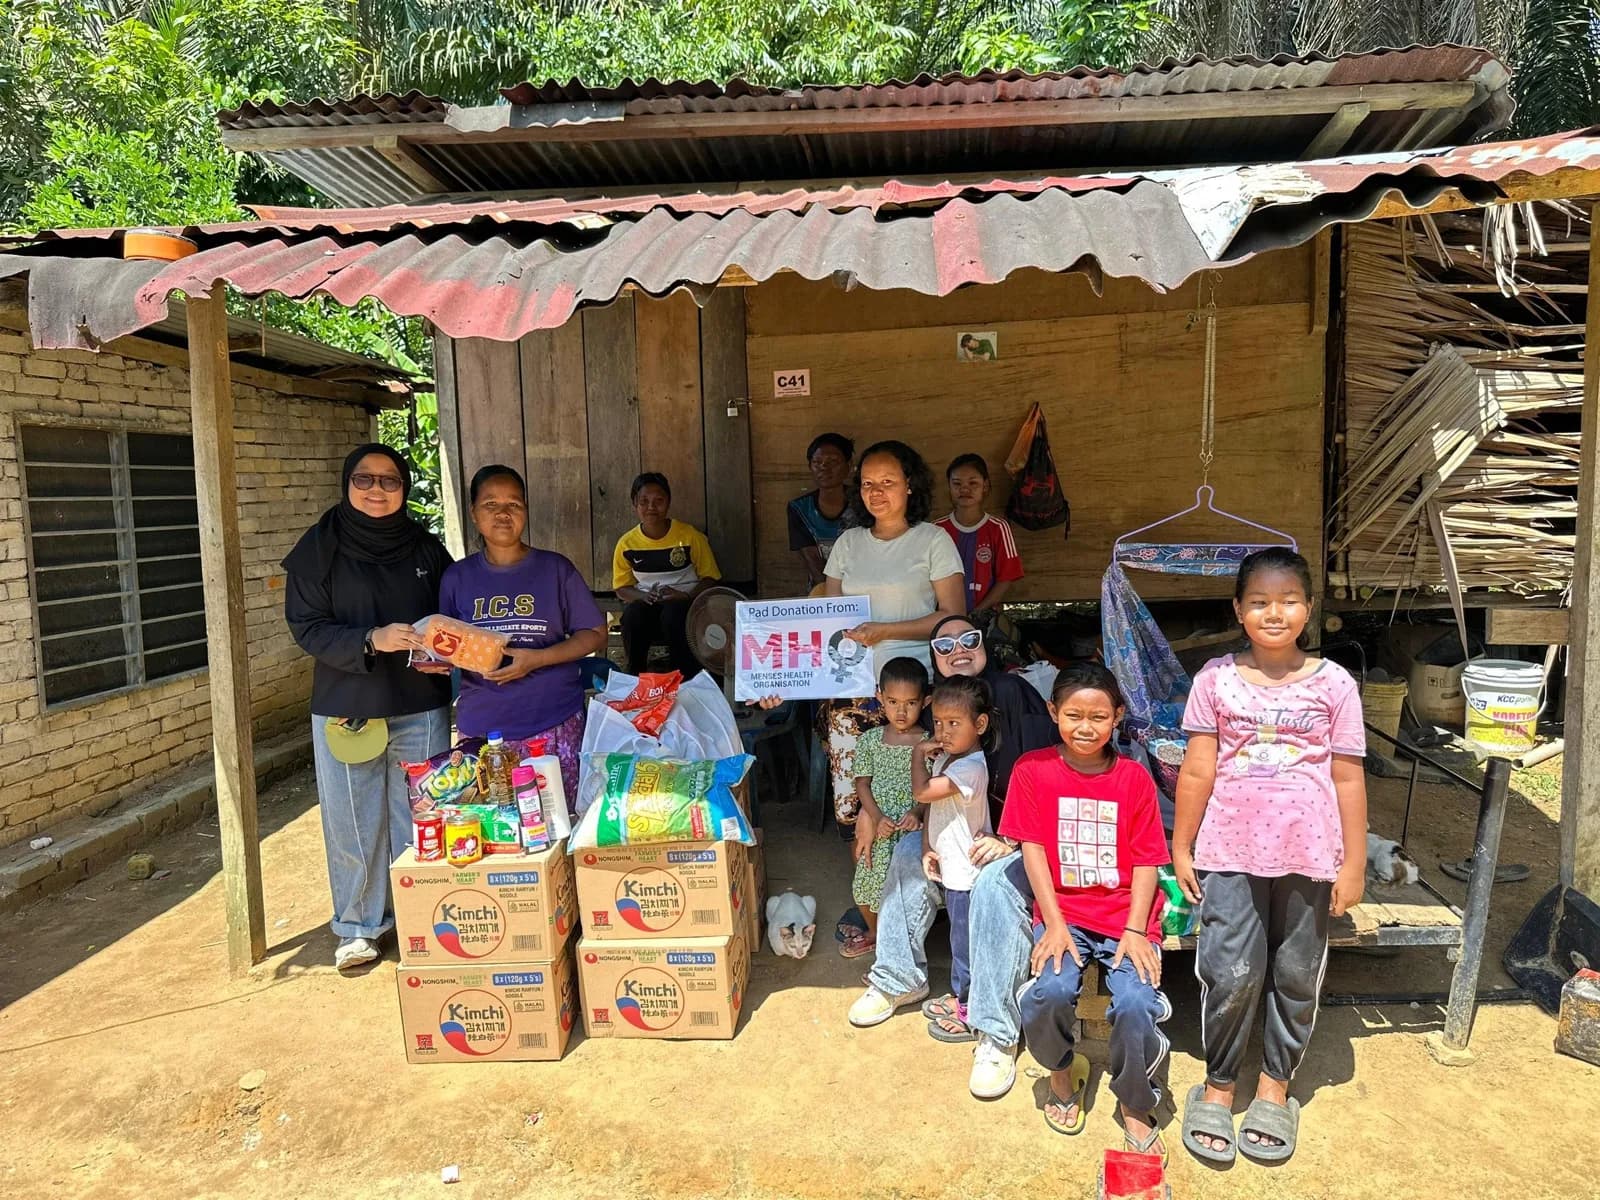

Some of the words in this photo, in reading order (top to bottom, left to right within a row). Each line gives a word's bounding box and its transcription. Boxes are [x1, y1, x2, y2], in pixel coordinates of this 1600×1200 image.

[778, 374, 804, 387] C41
[472, 594, 534, 620] I.C.S
[749, 607, 768, 618] Pad
[772, 602, 823, 616] Donation
[826, 602, 859, 613] From:
[751, 672, 782, 680] MENSES
[753, 680, 810, 688] ORGANISATION
[1270, 708, 1315, 733] Tasty
[628, 772, 662, 832] Spcial
[624, 880, 677, 897] Kimchi
[640, 899, 679, 909] 김치찌개
[441, 904, 497, 921] Kimchi
[459, 923, 499, 934] 김치찌개
[624, 980, 676, 997] Kimchi
[640, 999, 678, 1009] 김치찌개
[449, 1004, 503, 1021] Kimchi
[466, 1022, 505, 1032] 김치찌개
